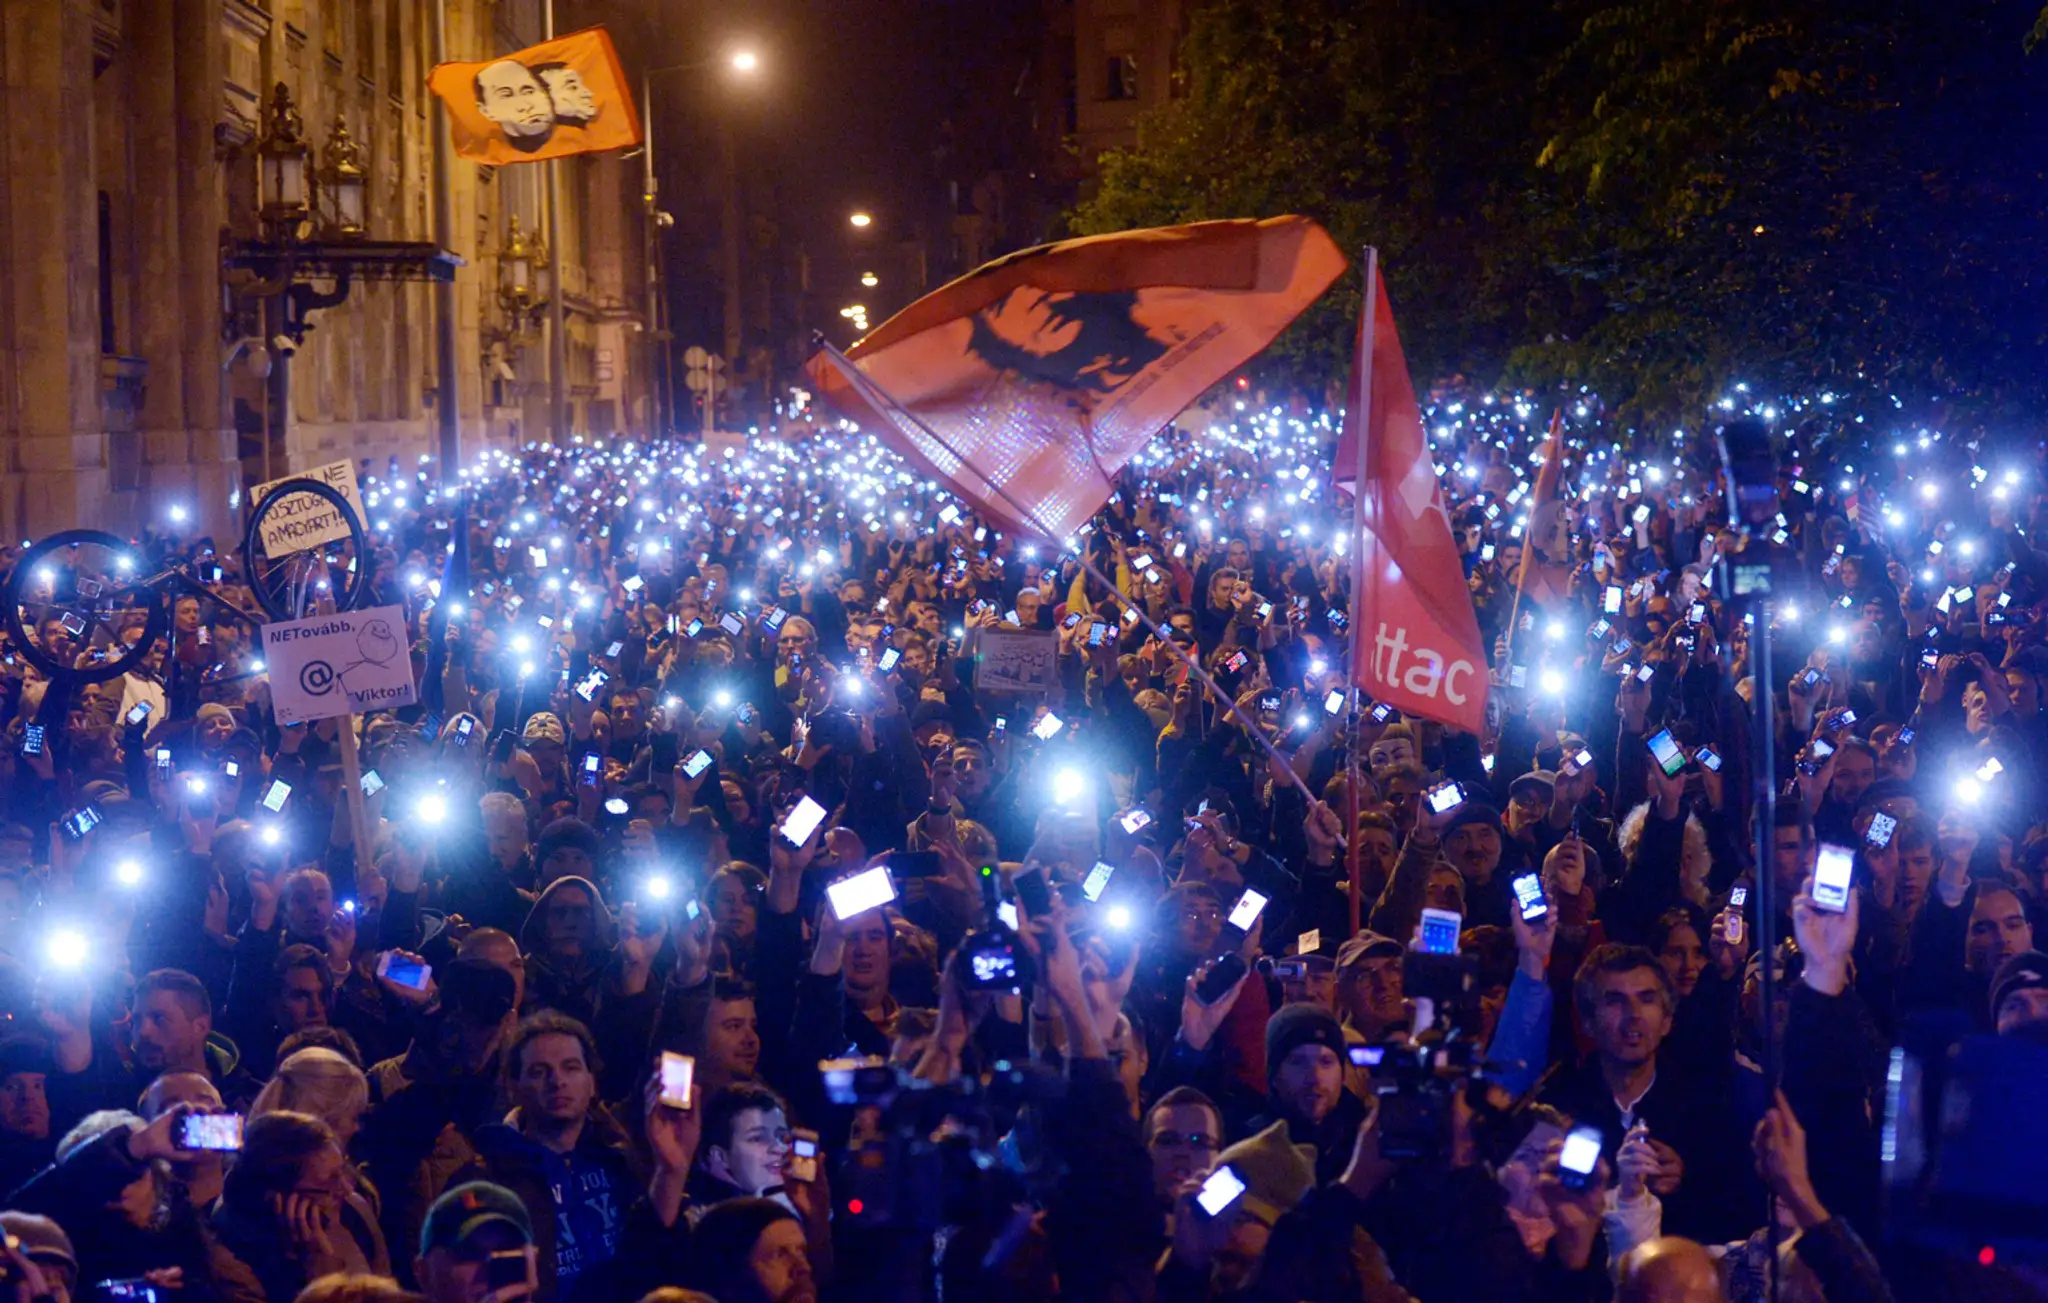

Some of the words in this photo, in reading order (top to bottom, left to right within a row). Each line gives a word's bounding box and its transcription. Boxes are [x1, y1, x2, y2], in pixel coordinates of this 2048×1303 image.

[322, 464, 347, 484] NE
[270, 621, 356, 643] NETovább,
[1370, 622, 1475, 706] ttac
[354, 684, 409, 703] Viktor!
